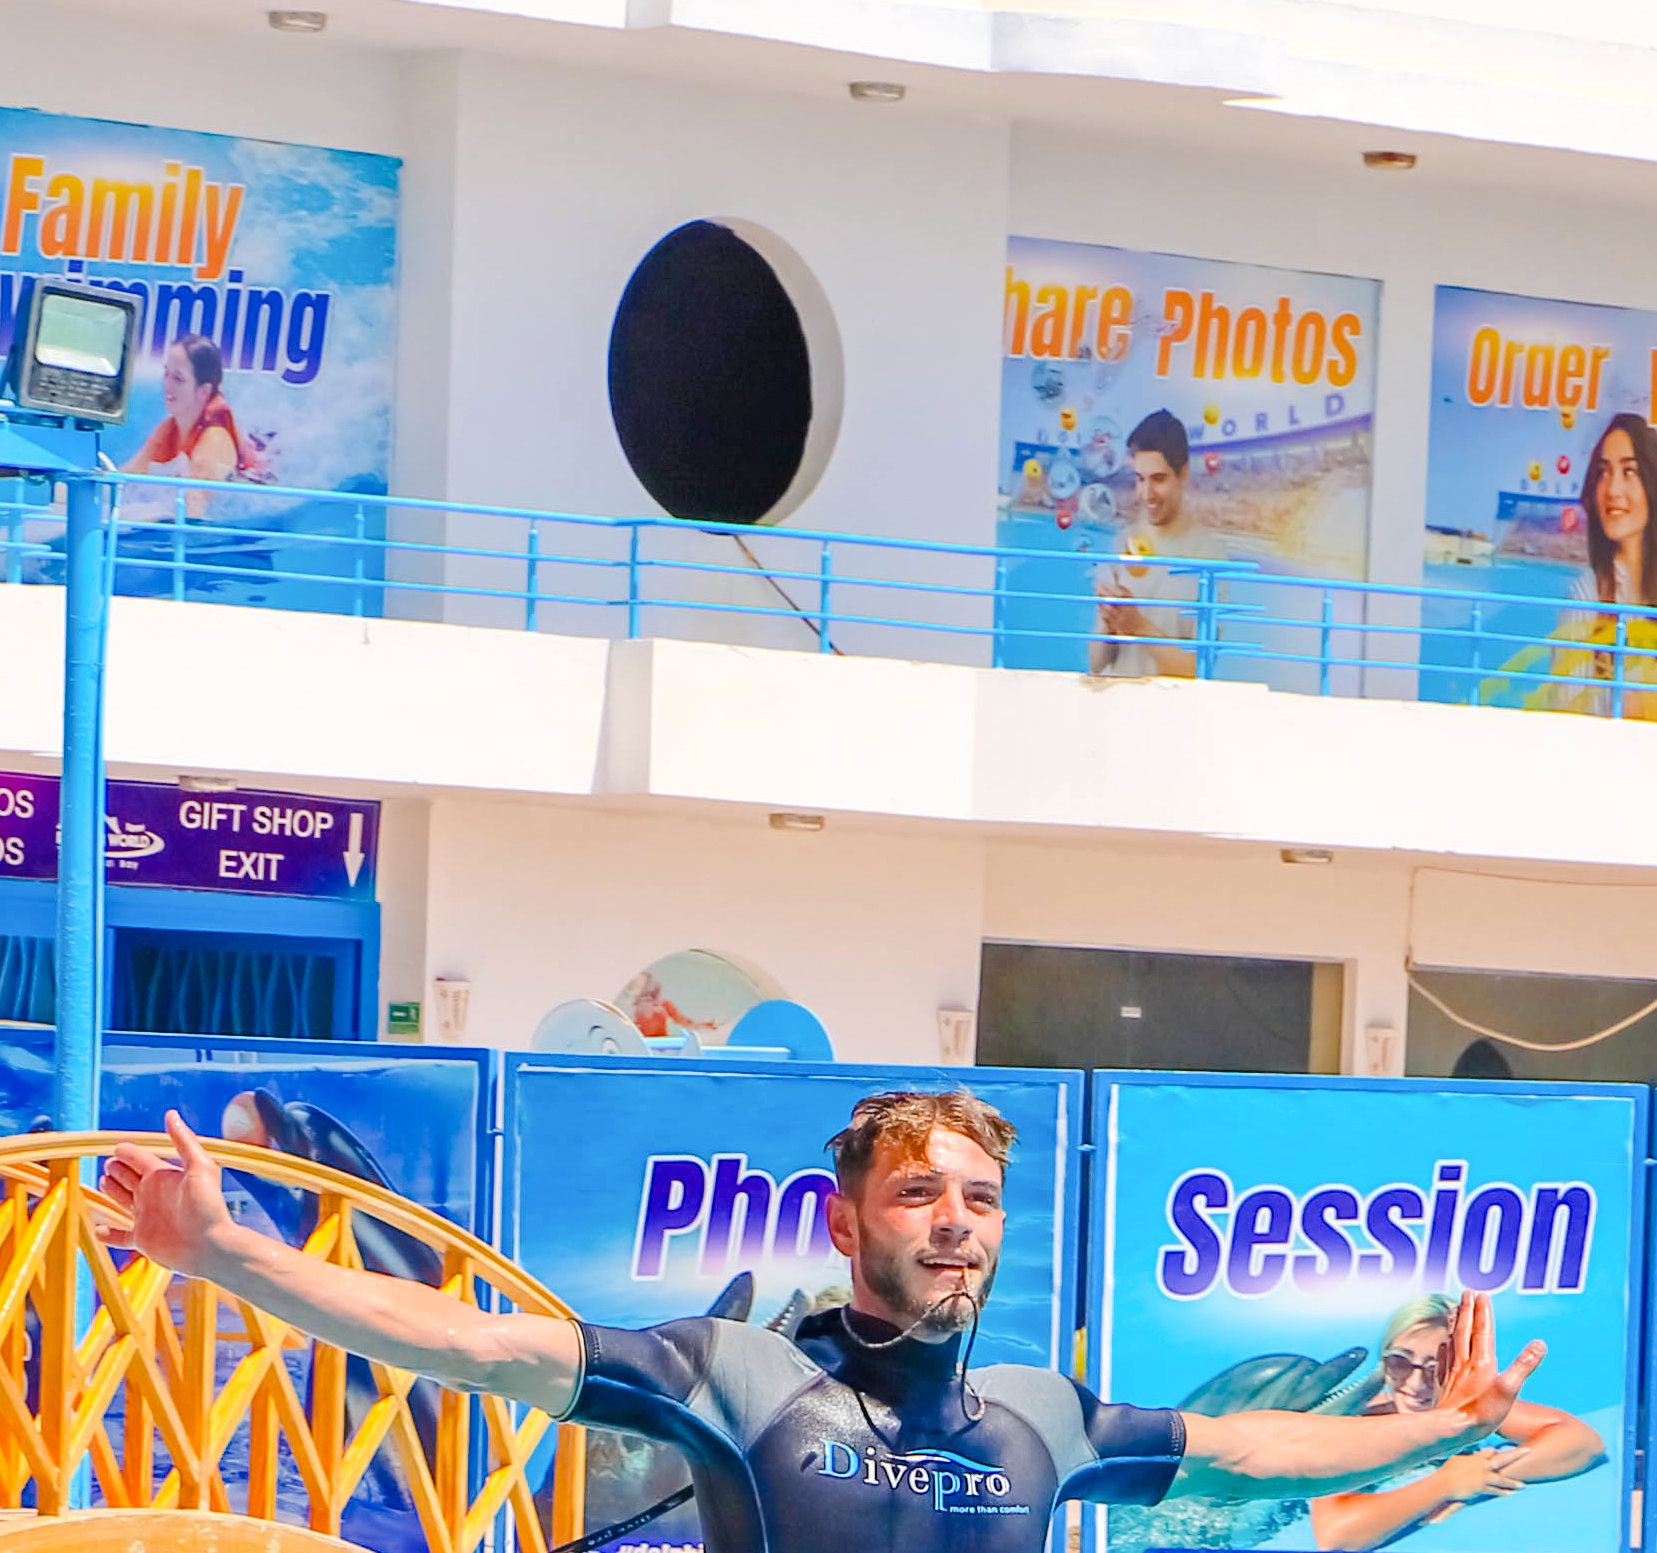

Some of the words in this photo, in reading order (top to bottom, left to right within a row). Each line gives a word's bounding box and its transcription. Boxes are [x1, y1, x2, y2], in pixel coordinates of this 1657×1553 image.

[1, 155, 246, 280] Family
[1155, 289, 1363, 388] Photos
[179, 800, 247, 832] GIFT
[252, 806, 335, 840] SHOP
[219, 849, 285, 881] EXIT
[1161, 1164, 1593, 1296] Session
